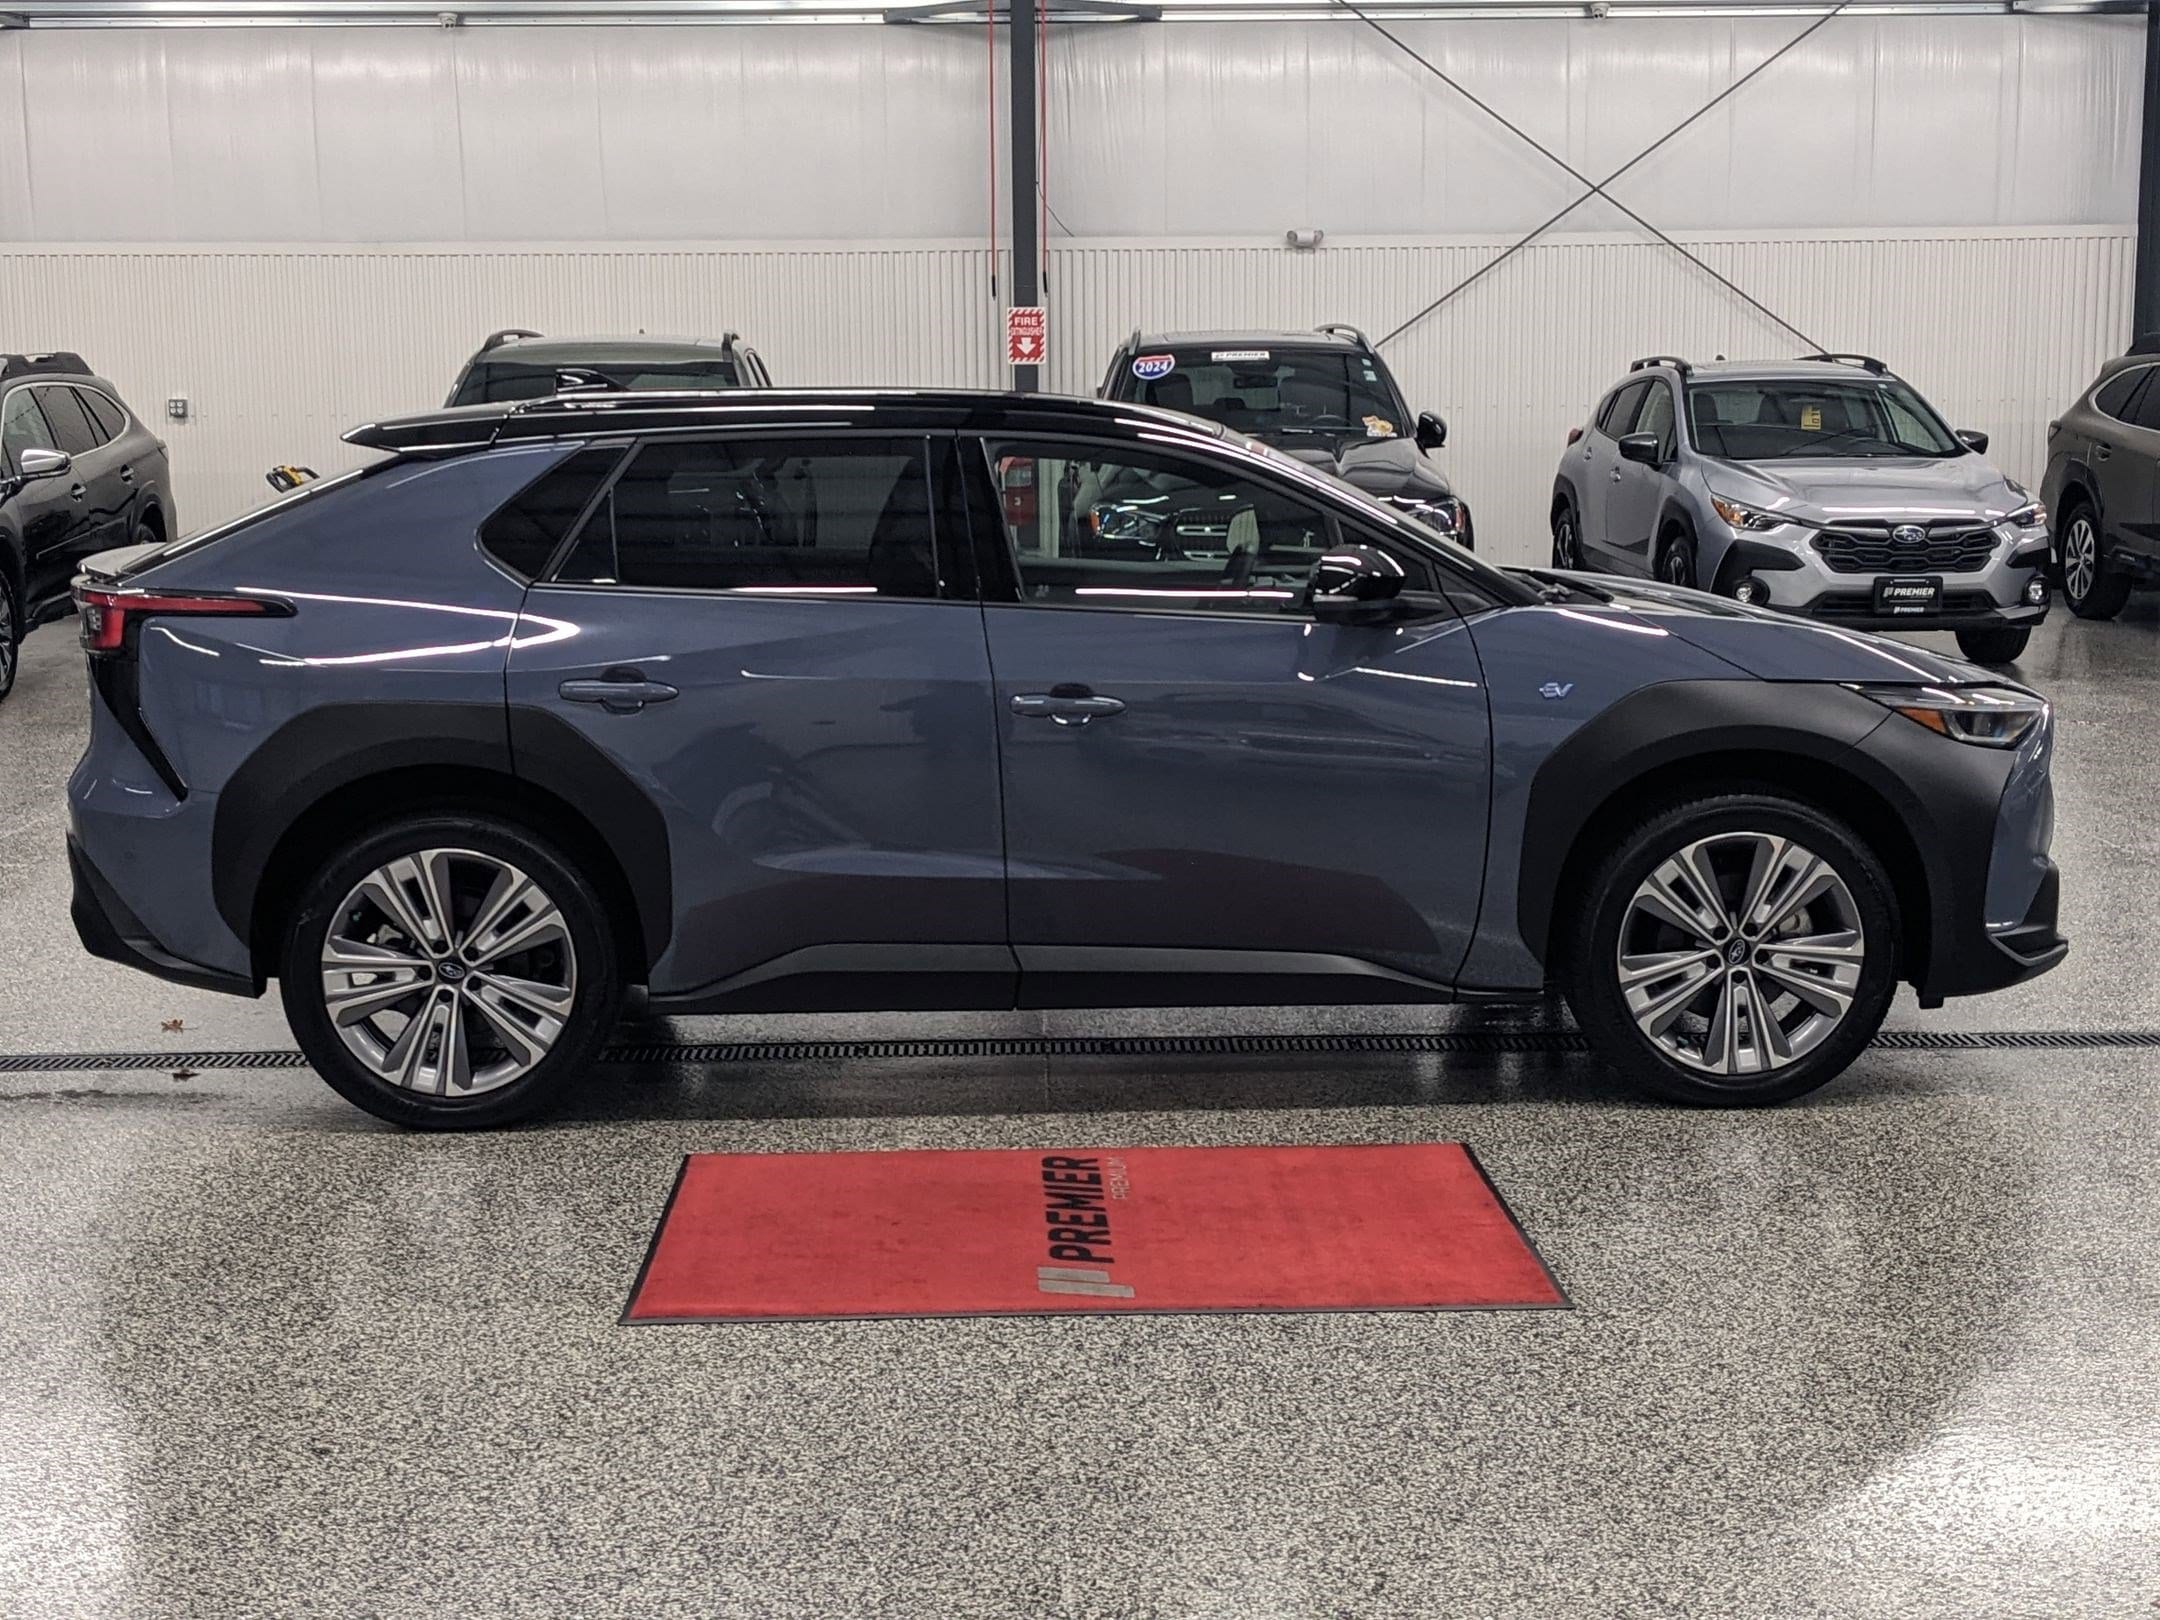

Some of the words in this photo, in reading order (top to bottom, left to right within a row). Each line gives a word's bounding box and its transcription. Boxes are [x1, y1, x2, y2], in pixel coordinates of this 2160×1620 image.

[1014, 316, 1038, 326] FIRE
[1138, 361, 1169, 373] 2024
[1893, 587, 1935, 597] PREMIER
[1538, 682, 1574, 698] EV
[1105, 1156, 1130, 1200] PREMIUM
[1041, 1156, 1115, 1263] PREMIER
